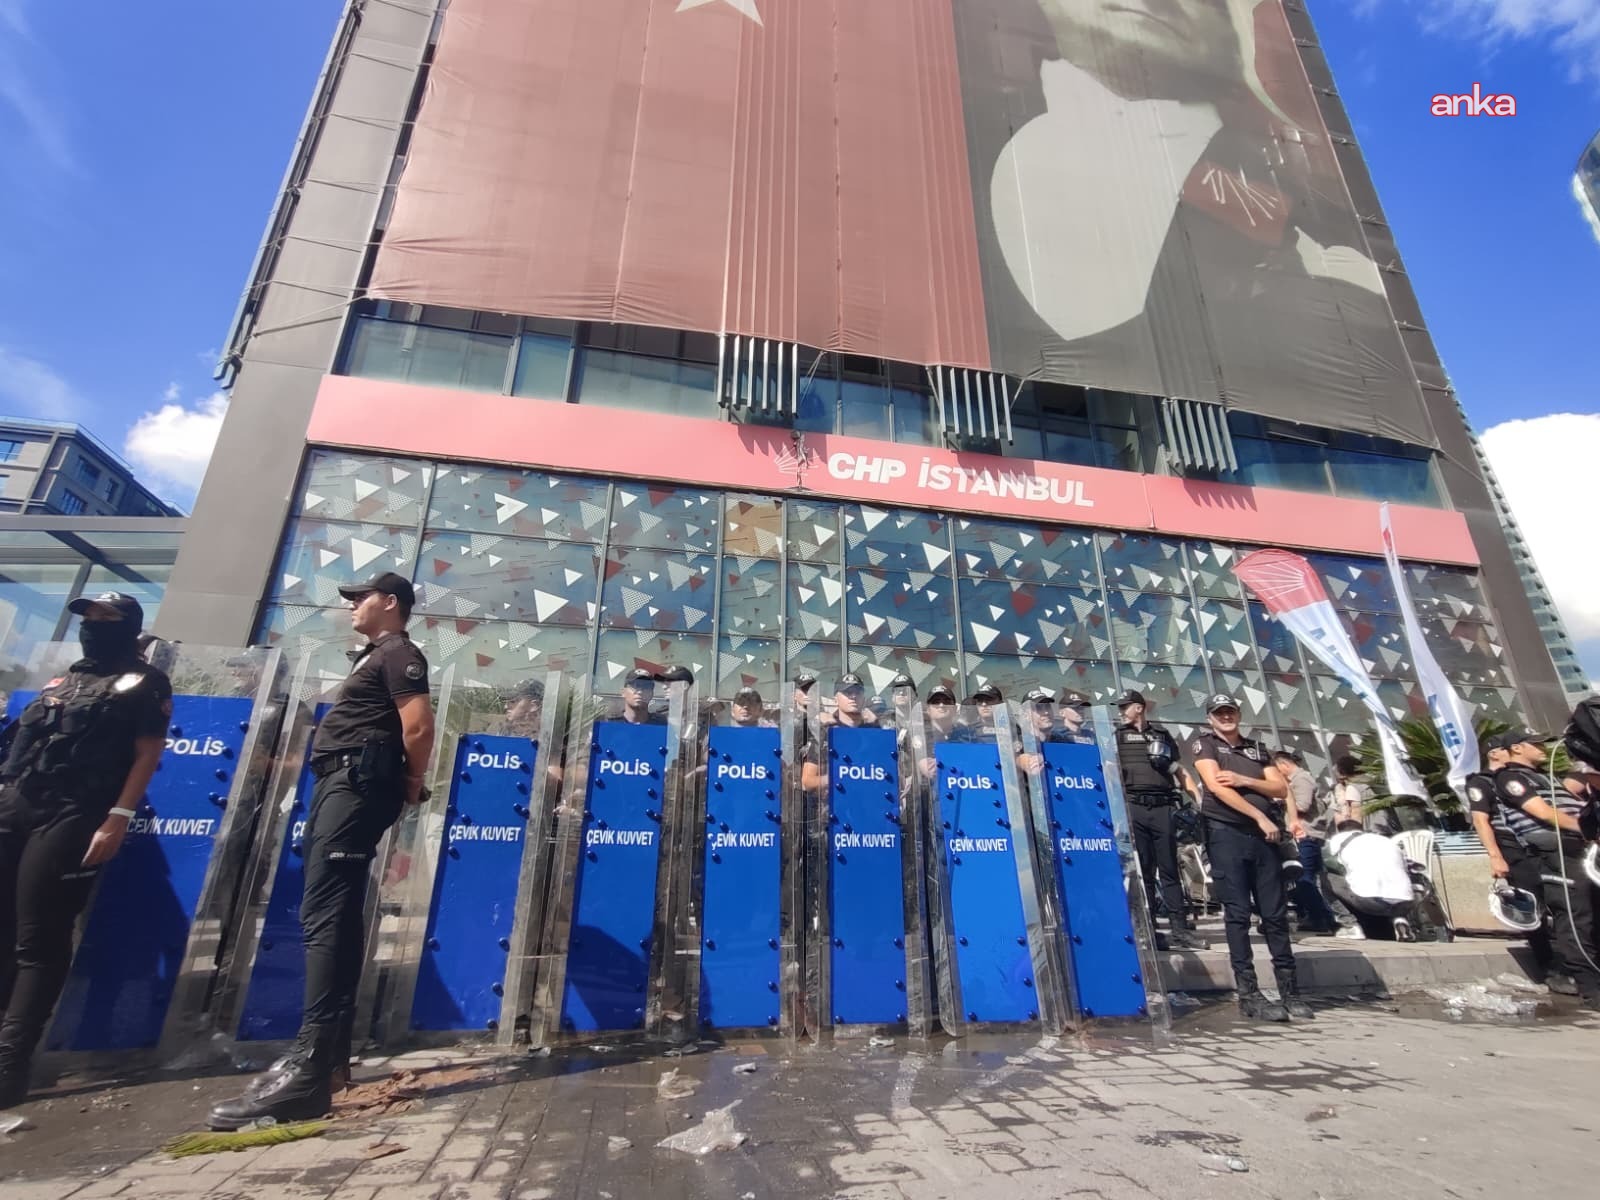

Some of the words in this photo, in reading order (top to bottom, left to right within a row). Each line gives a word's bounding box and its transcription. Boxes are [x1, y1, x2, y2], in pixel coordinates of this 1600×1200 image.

[828, 452, 906, 485] CHP
[917, 456, 1094, 507] İSTANBUL
[466, 752, 521, 770] POLİS
[600, 758, 651, 776] POLİS
[717, 762, 766, 779] POLİS
[839, 764, 885, 780] POLİS
[947, 774, 991, 789] POLİS
[1054, 775, 1094, 790] POLİS
[163, 818, 215, 836] KUVVET
[480, 826, 521, 842] KUVVET
[586, 828, 614, 847] ÇEVİK
[616, 830, 653, 846] KUVVET
[739, 832, 775, 847] KUVVET
[835, 830, 860, 850] ÇEVİK
[862, 833, 895, 848] KUVVET
[976, 838, 1007, 851] KUVVET
[1084, 838, 1112, 851] KUVVET
